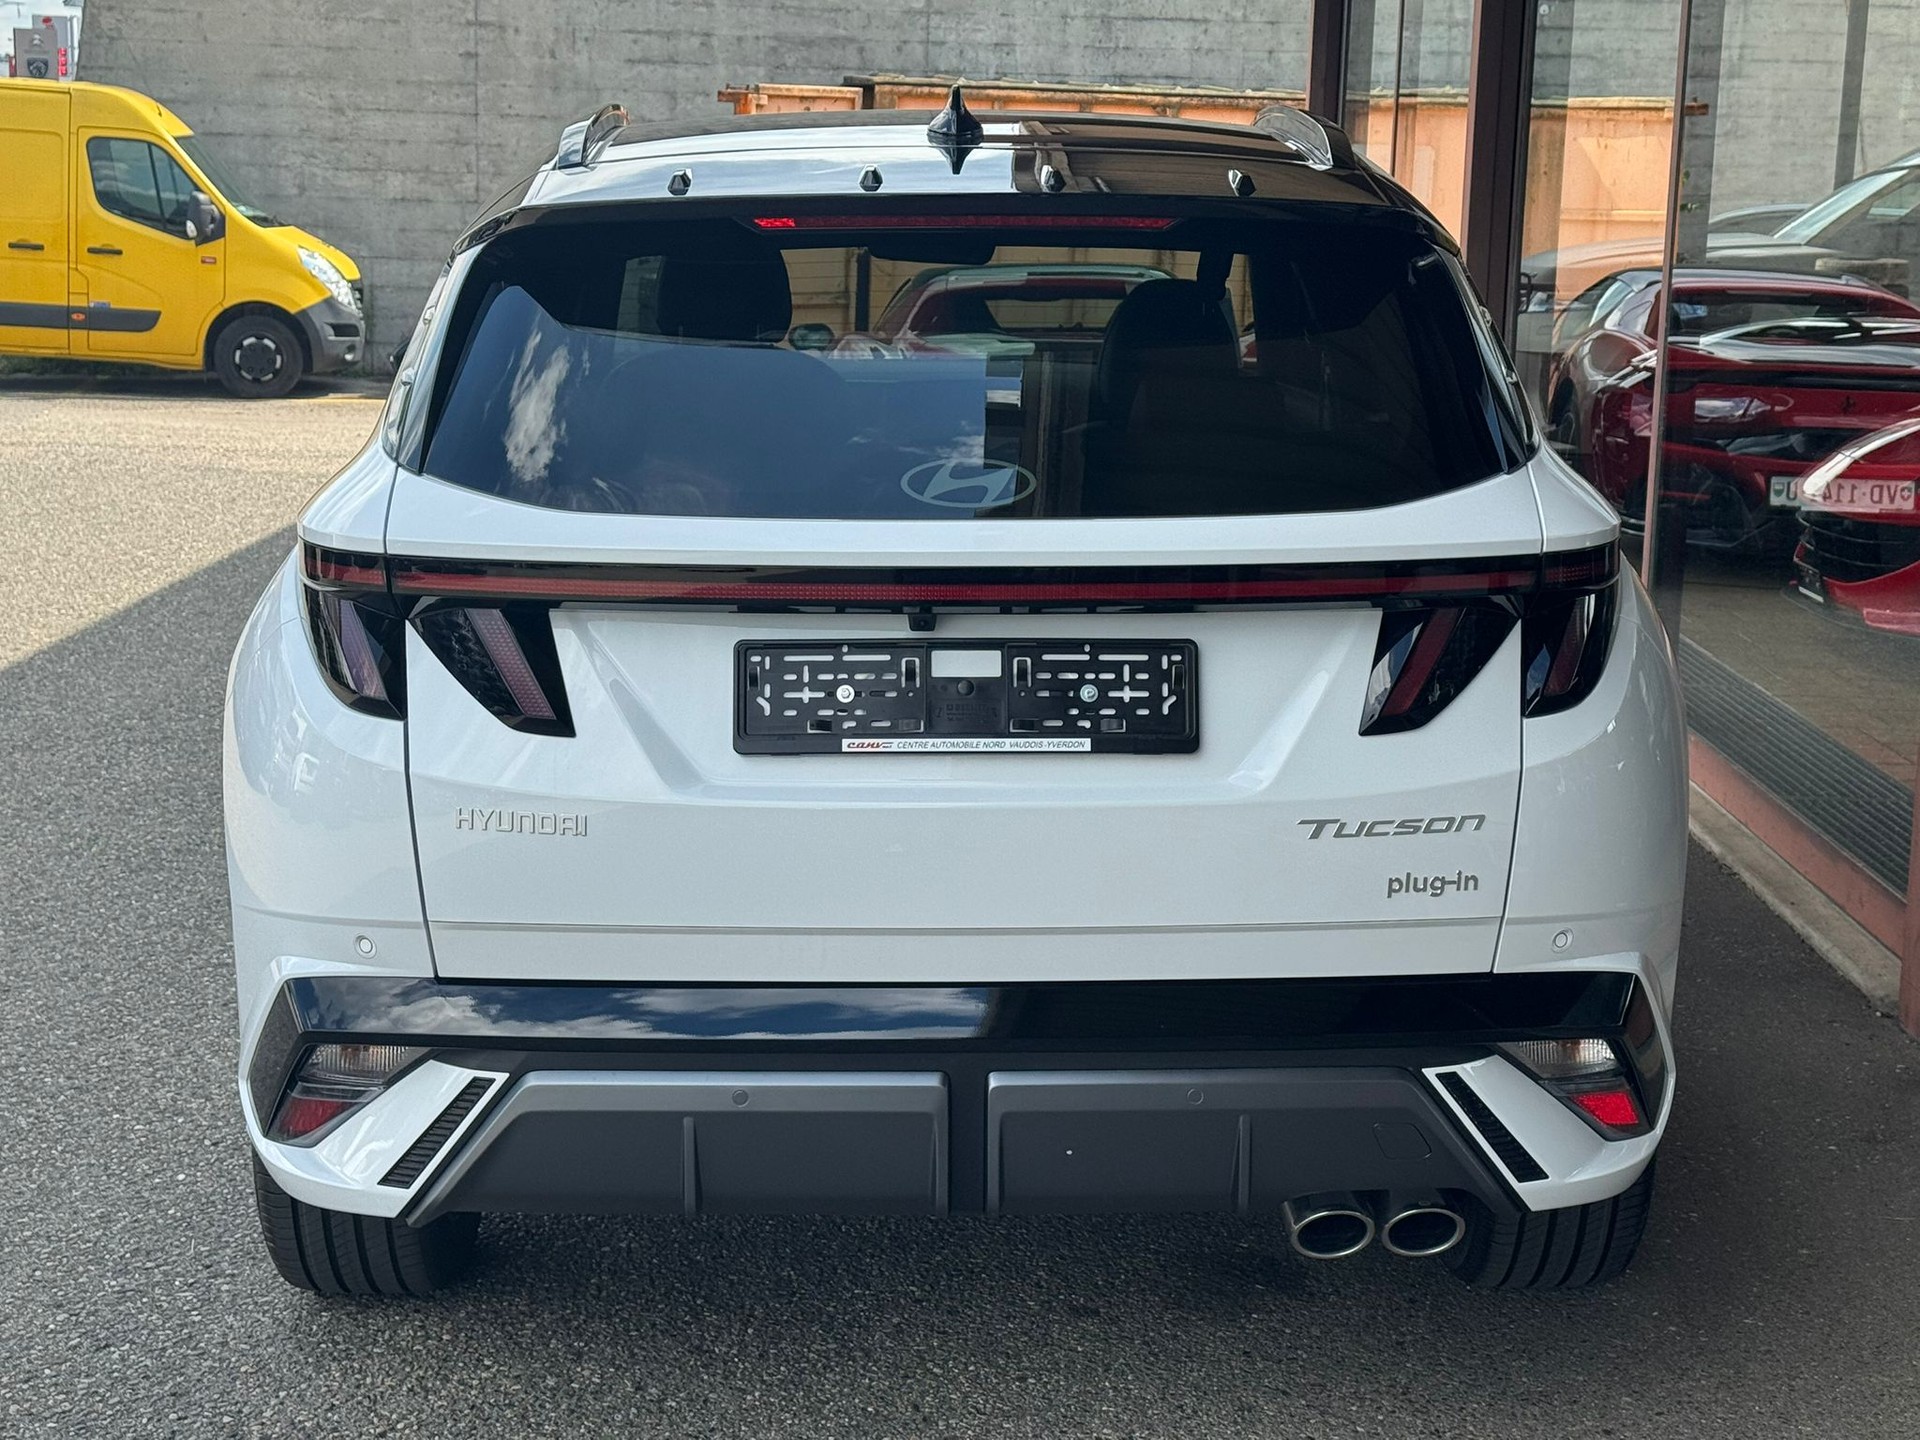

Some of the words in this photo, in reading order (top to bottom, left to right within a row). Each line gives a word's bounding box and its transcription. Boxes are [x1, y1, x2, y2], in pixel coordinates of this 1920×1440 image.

[897, 741, 929, 749] CENTRE
[930, 741, 981, 749] AUTOMOBILE
[982, 741, 1006, 749] NORD
[455, 806, 588, 837] HYUNDAI
[1386, 869, 1480, 899] plug-in
